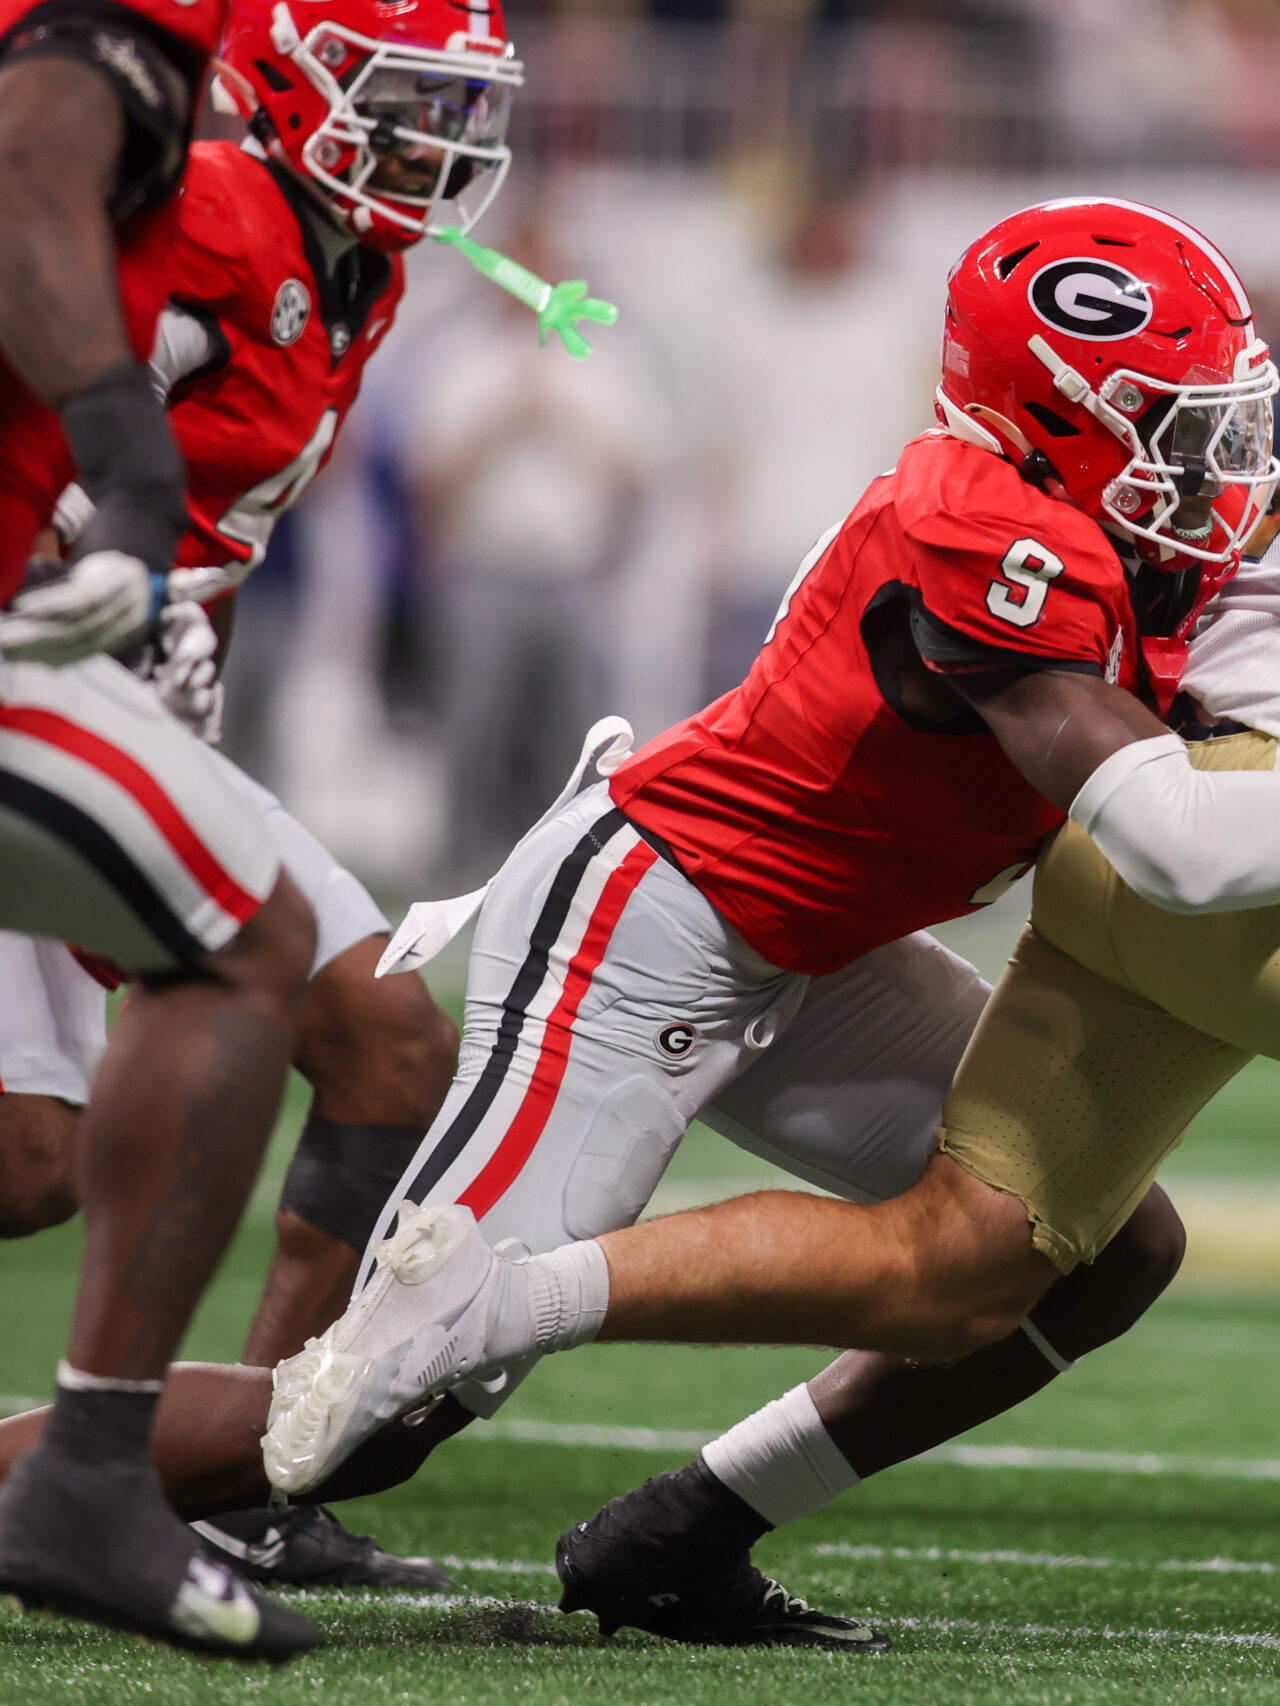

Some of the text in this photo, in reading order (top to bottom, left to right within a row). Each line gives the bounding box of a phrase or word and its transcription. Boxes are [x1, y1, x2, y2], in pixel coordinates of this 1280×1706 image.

[1031, 260, 1149, 337] G
[984, 536, 1065, 628] 9
[658, 1025, 694, 1056] G
